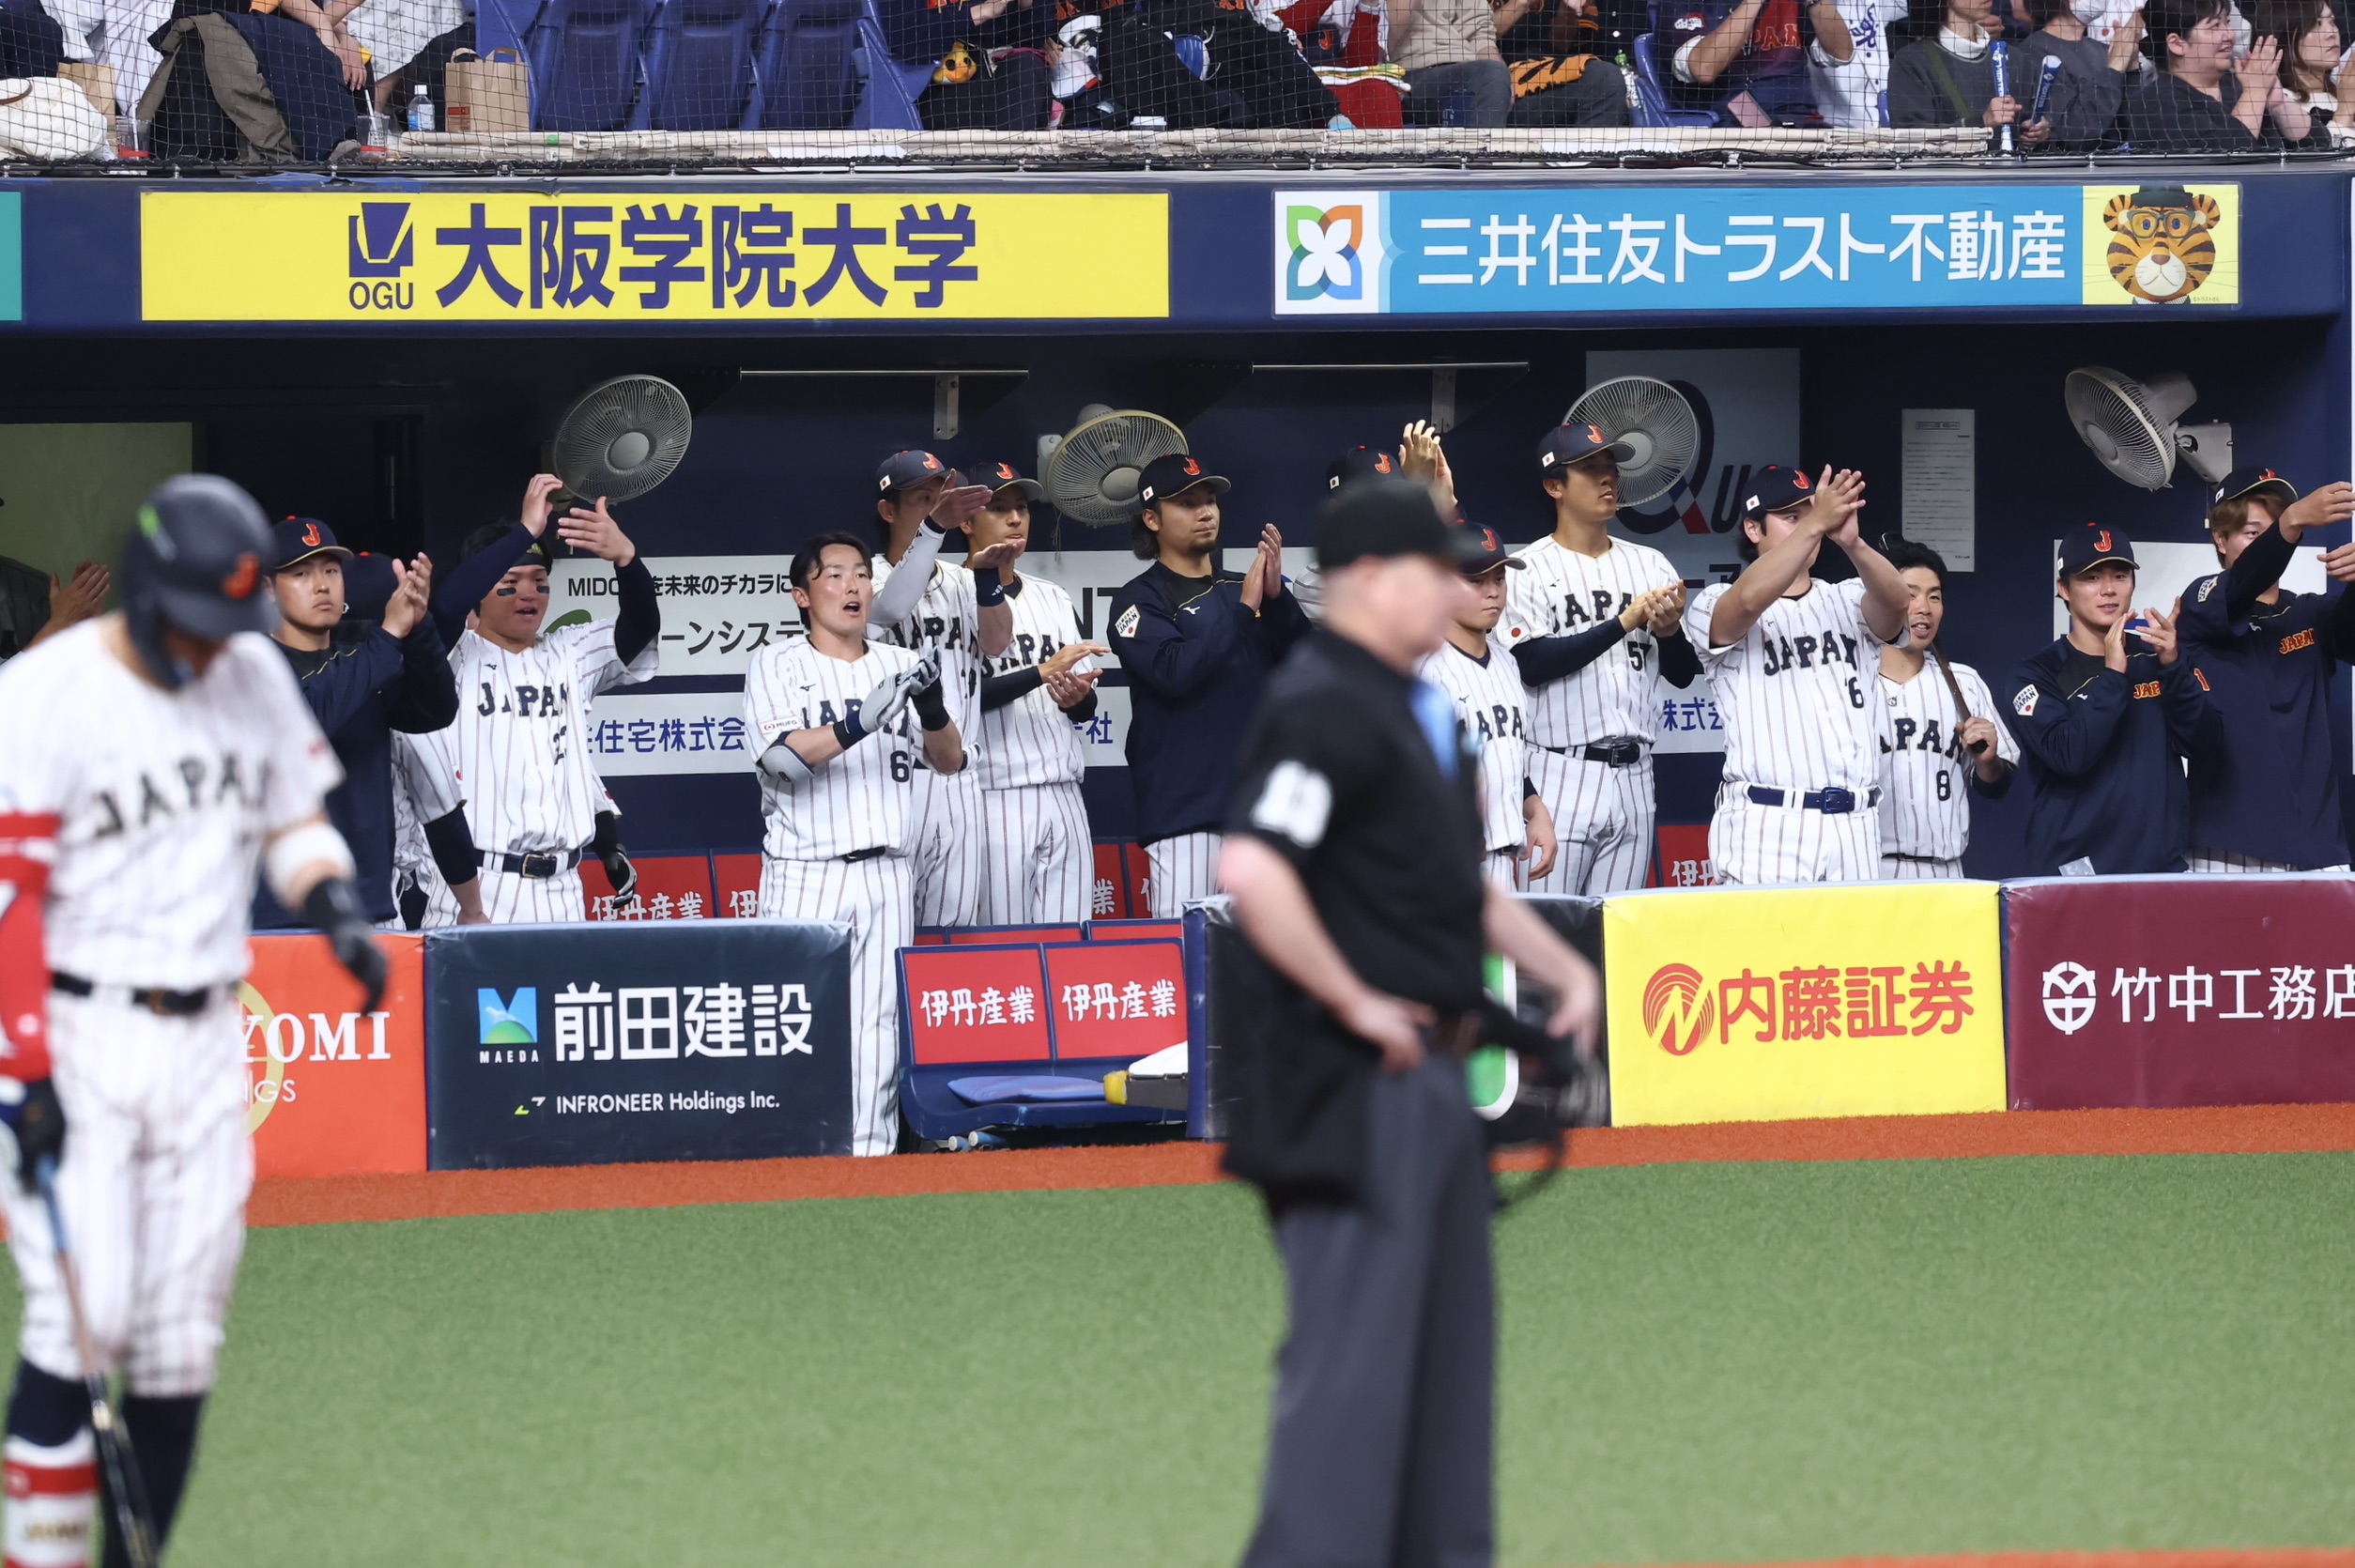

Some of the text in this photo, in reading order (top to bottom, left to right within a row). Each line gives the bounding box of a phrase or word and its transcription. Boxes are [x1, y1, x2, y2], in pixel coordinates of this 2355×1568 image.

[436, 203, 978, 309] 大阪学院大学
[1418, 210, 2065, 285] 三井住友トラスト不動産
[348, 282, 414, 310] OGU
[1183, 456, 1201, 476] J
[1375, 453, 1391, 474] J
[301, 523, 321, 546] J
[1481, 528, 1497, 551] J
[2093, 530, 2112, 553] J
[588, 716, 746, 754] 住宅株式会
[776, 719, 797, 728] MUFG
[890, 750, 910, 783] 6
[1936, 770, 1951, 801] 8
[920, 985, 1035, 1027] 伊丹産業
[1061, 978, 1176, 1022] 伊丹産業
[1718, 960, 1974, 1044] 内藤証券
[554, 981, 812, 1062] 前田建設
[479, 1050, 539, 1064] MAEDA
[556, 1090, 780, 1115] INFRONEER Holdings Inc.
